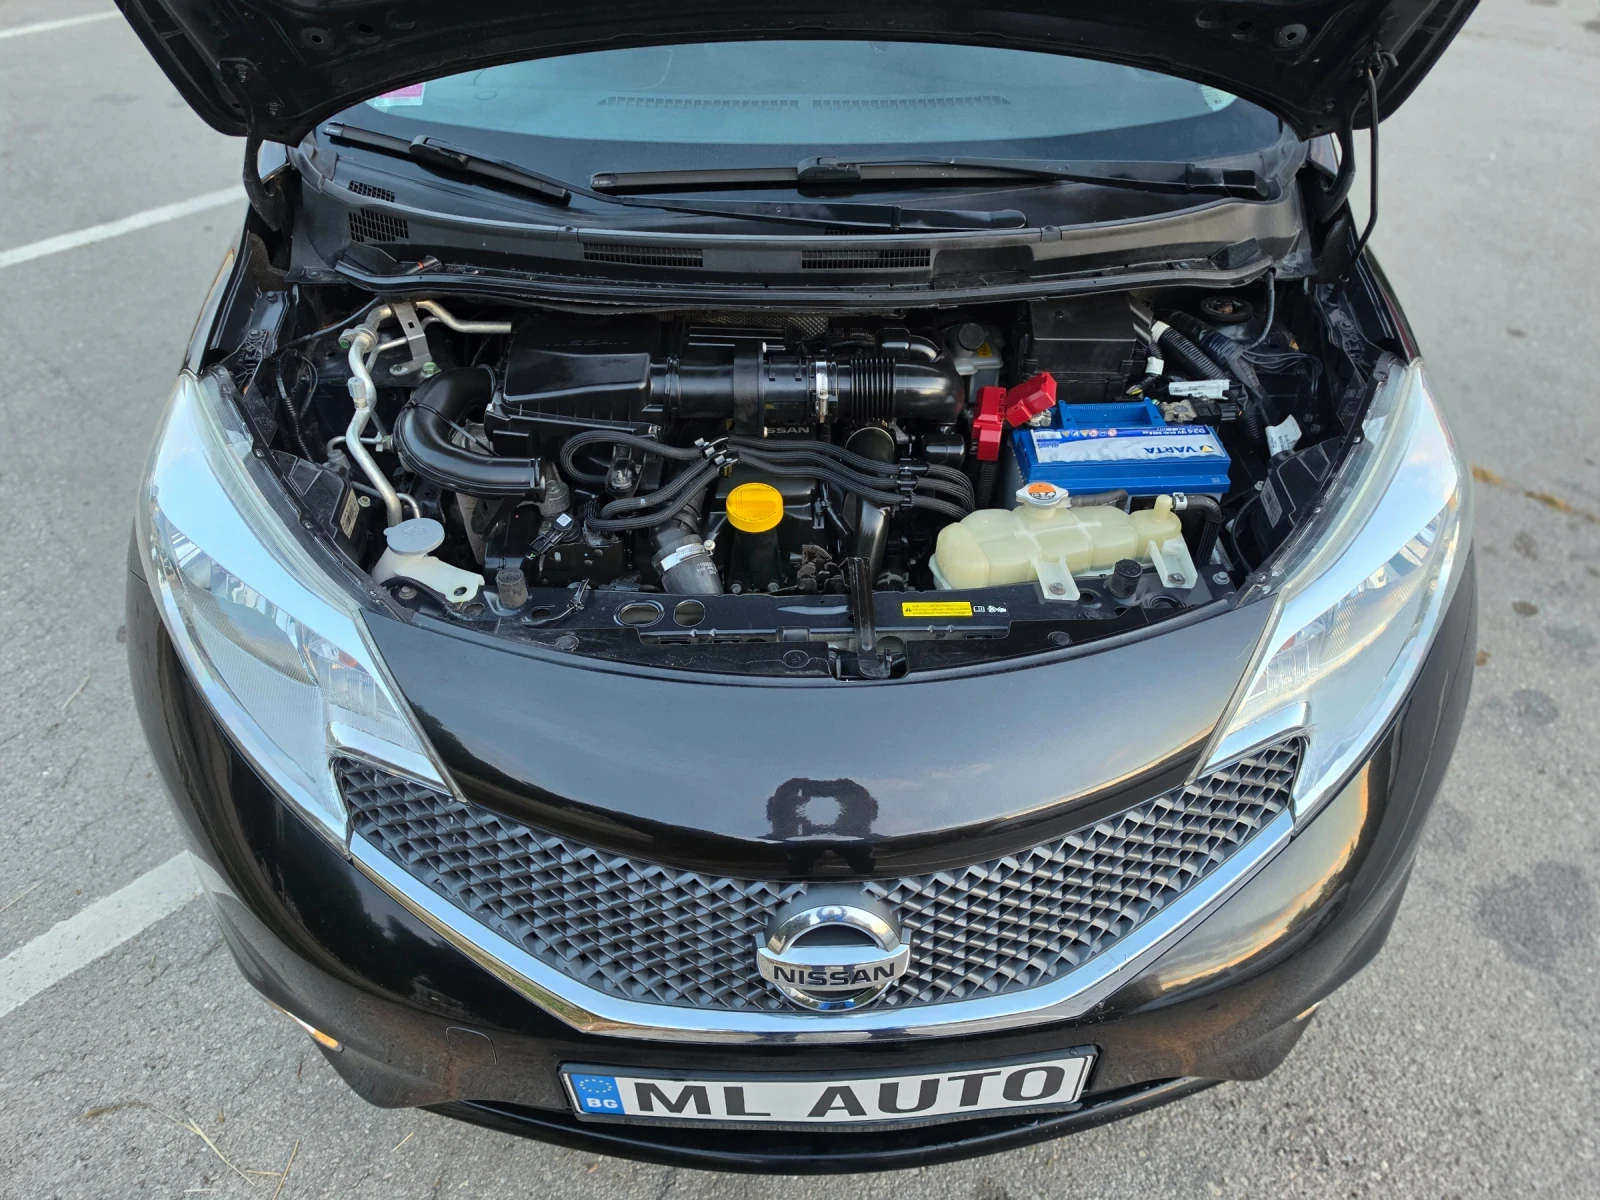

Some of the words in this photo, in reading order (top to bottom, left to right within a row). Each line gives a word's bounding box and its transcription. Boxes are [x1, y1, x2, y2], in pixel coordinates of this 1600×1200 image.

[1143, 445, 1198, 454] VARTA
[773, 963, 895, 986] NISSAN
[634, 1082, 771, 1117] ML
[807, 1065, 1065, 1117] AUTO
[586, 1097, 618, 1109] BG
